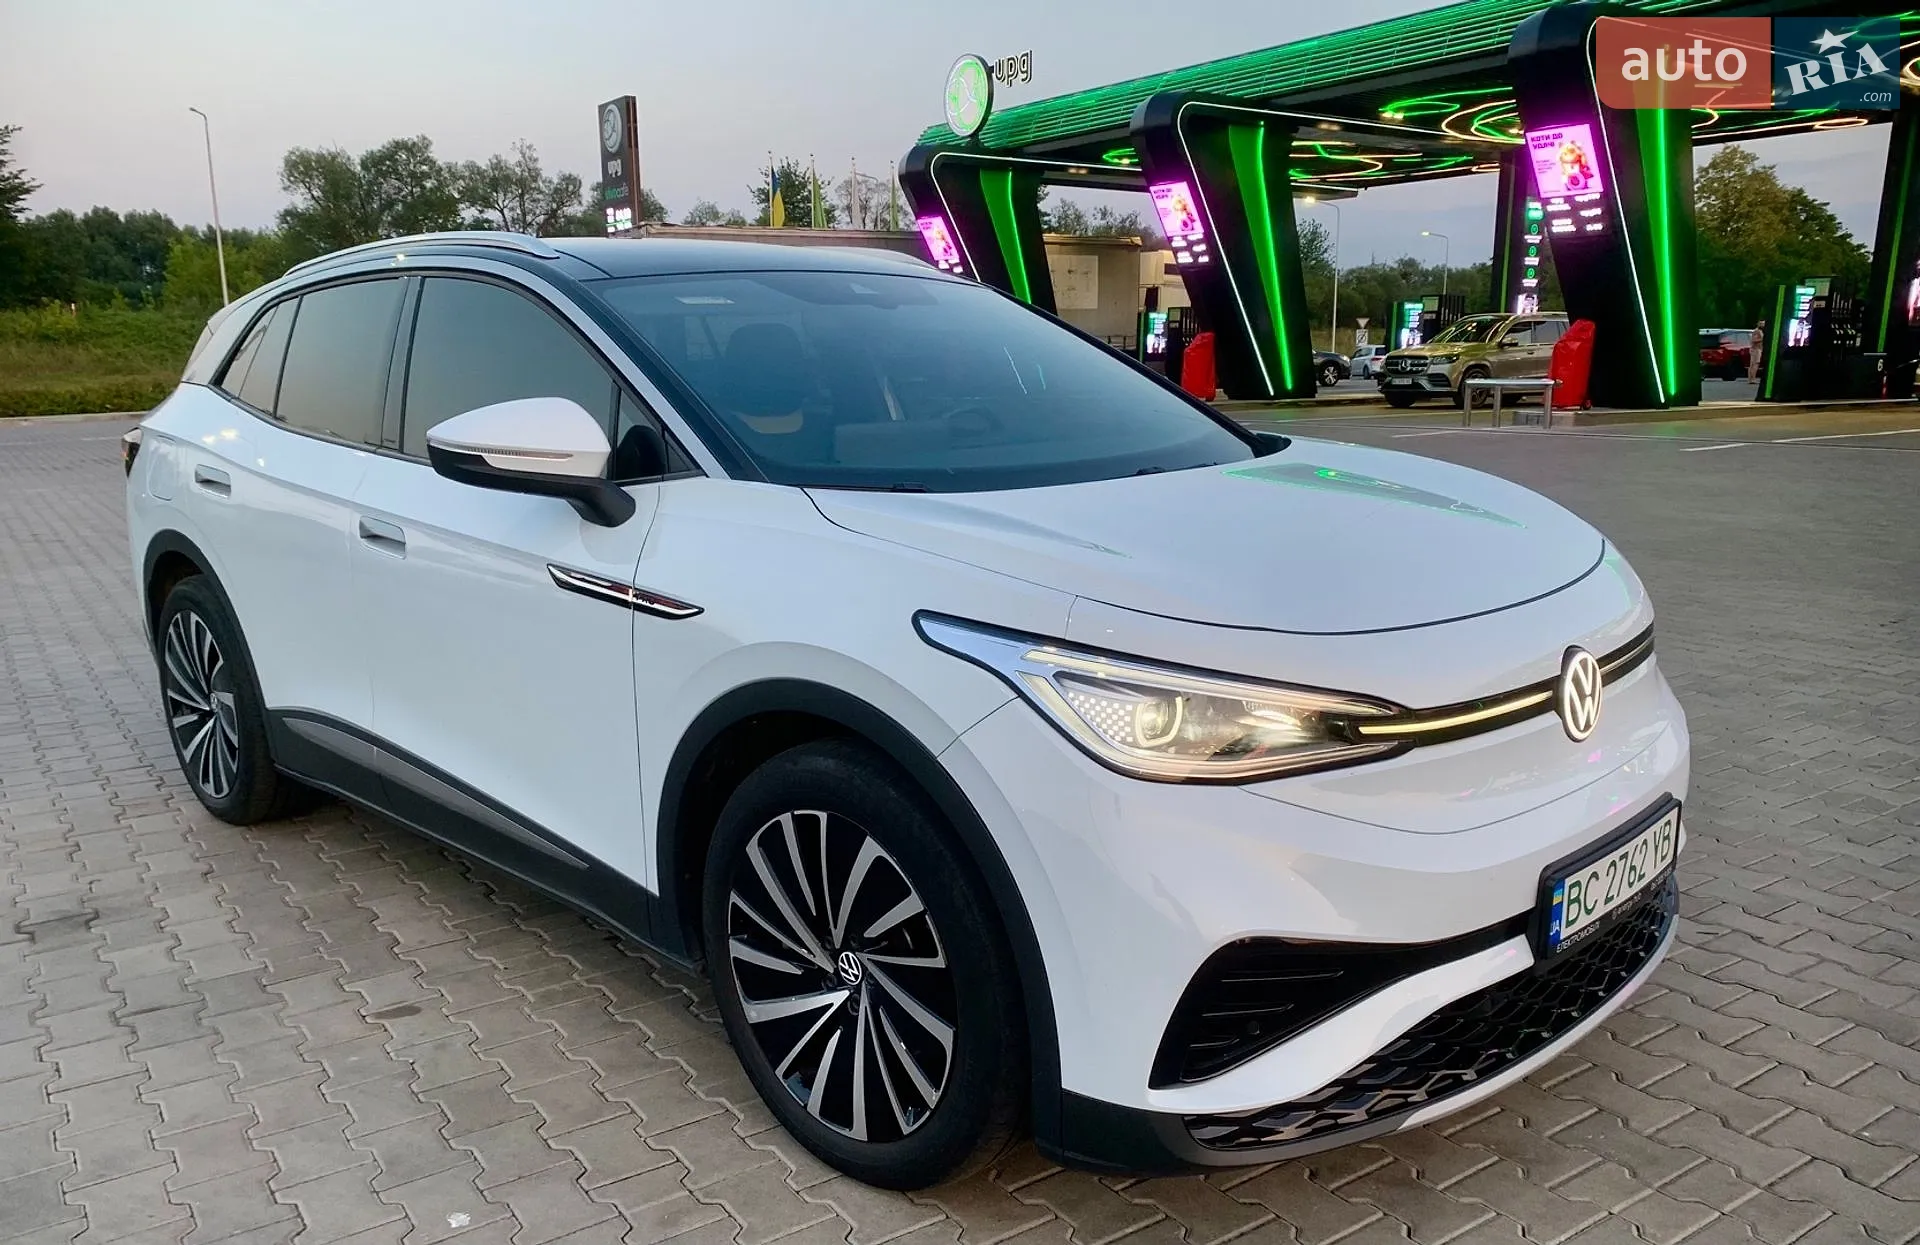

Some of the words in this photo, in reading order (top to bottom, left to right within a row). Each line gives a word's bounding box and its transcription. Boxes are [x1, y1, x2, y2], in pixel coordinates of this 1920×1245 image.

[994, 49, 1033, 88] upg
[1566, 871, 1600, 929] BC
[1604, 839, 1648, 905] 2762
